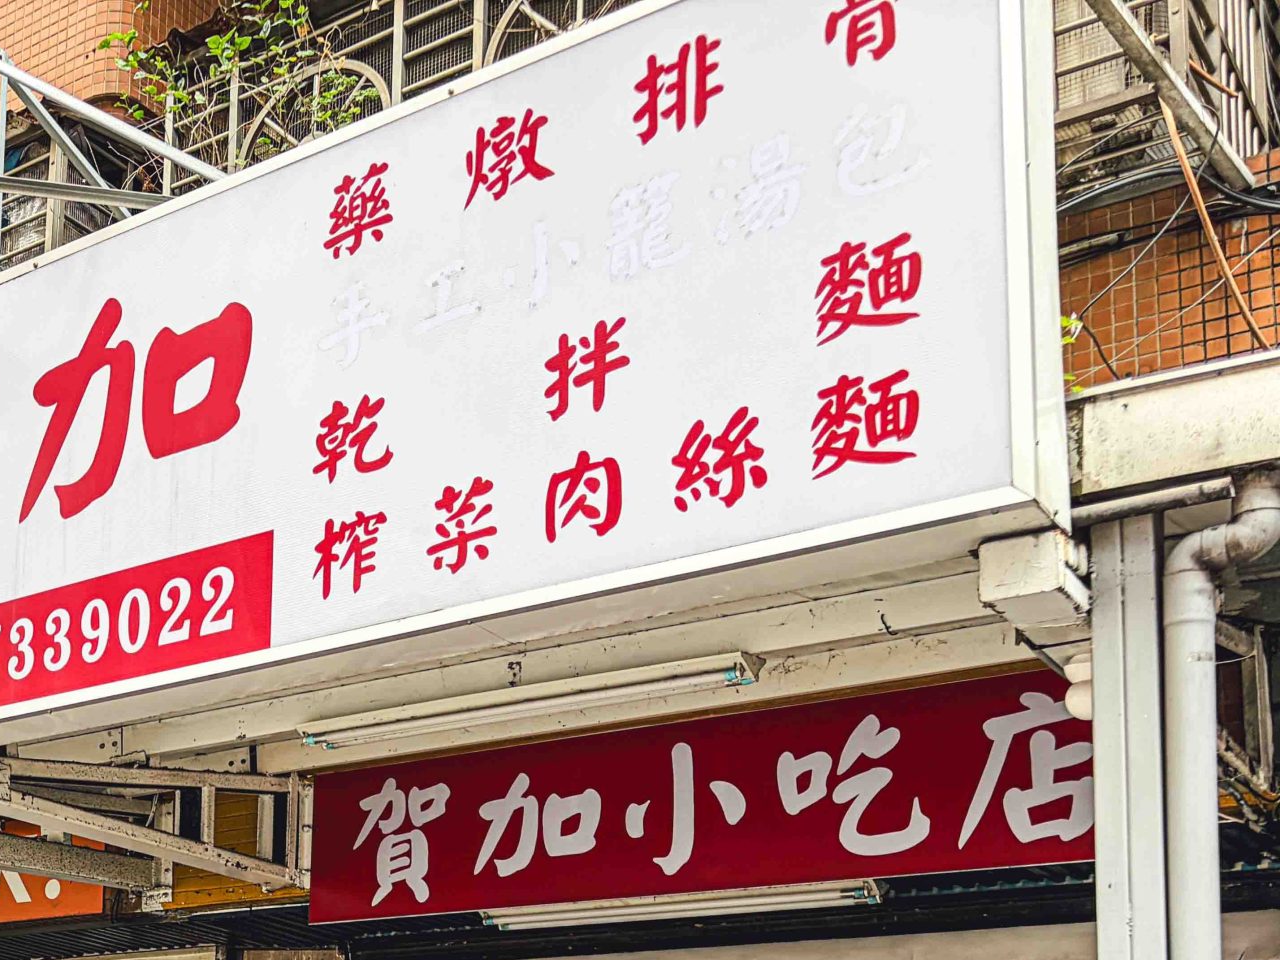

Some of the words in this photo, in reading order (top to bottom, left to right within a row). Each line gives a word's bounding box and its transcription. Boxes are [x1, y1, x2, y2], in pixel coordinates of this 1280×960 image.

[313, 232, 922, 484] 乾拌麵
[313, 369, 922, 600] 榨菜肉絲麵
[352, 692, 1094, 907] 賀加小吃店
